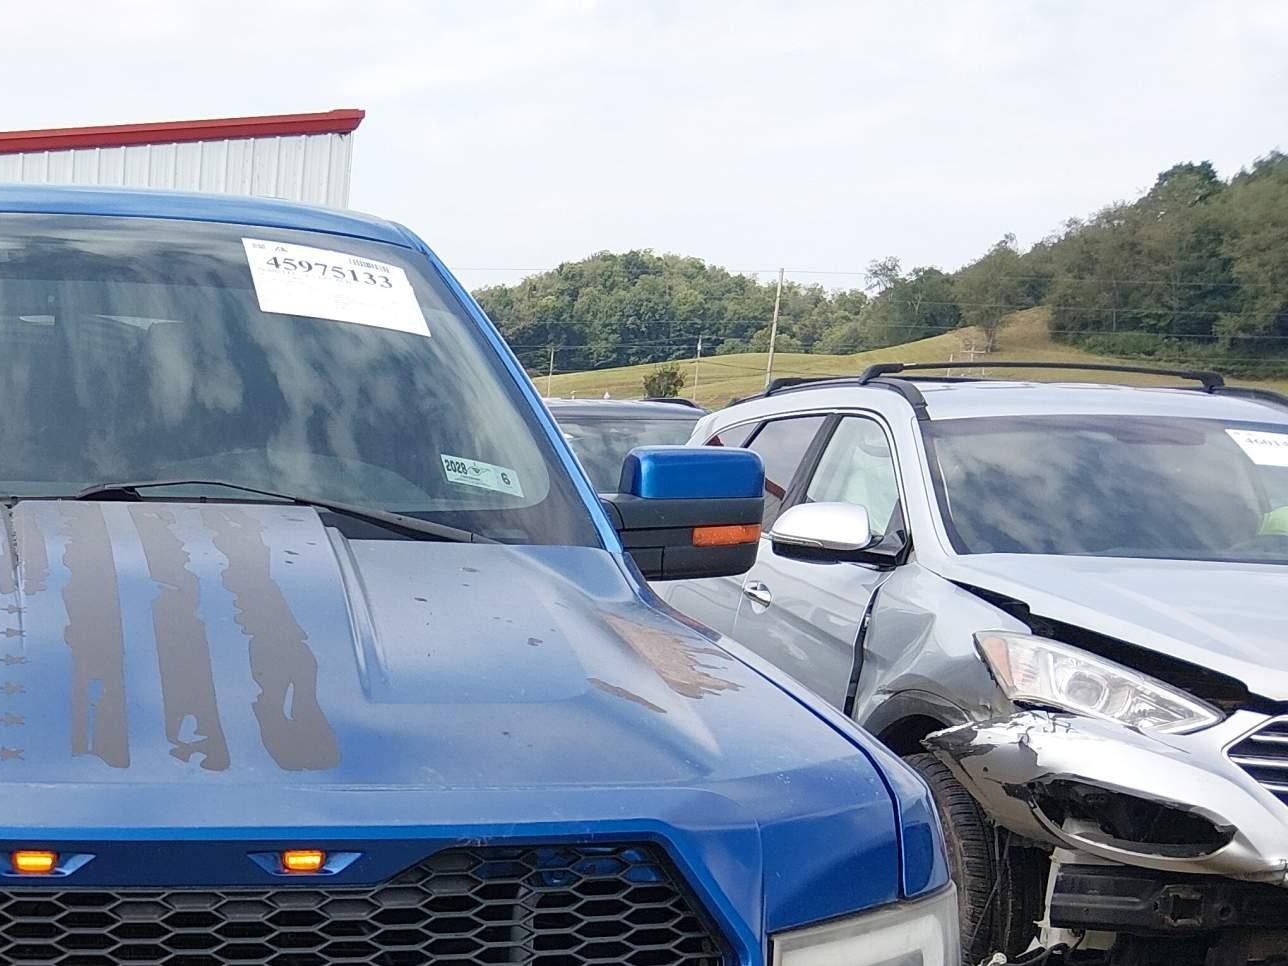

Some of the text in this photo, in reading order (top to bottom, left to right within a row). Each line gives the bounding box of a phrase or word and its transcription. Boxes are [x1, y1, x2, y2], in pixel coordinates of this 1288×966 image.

[266, 255, 393, 289] 45975133
[445, 459, 468, 475] 2028
[500, 472, 511, 486] 6
